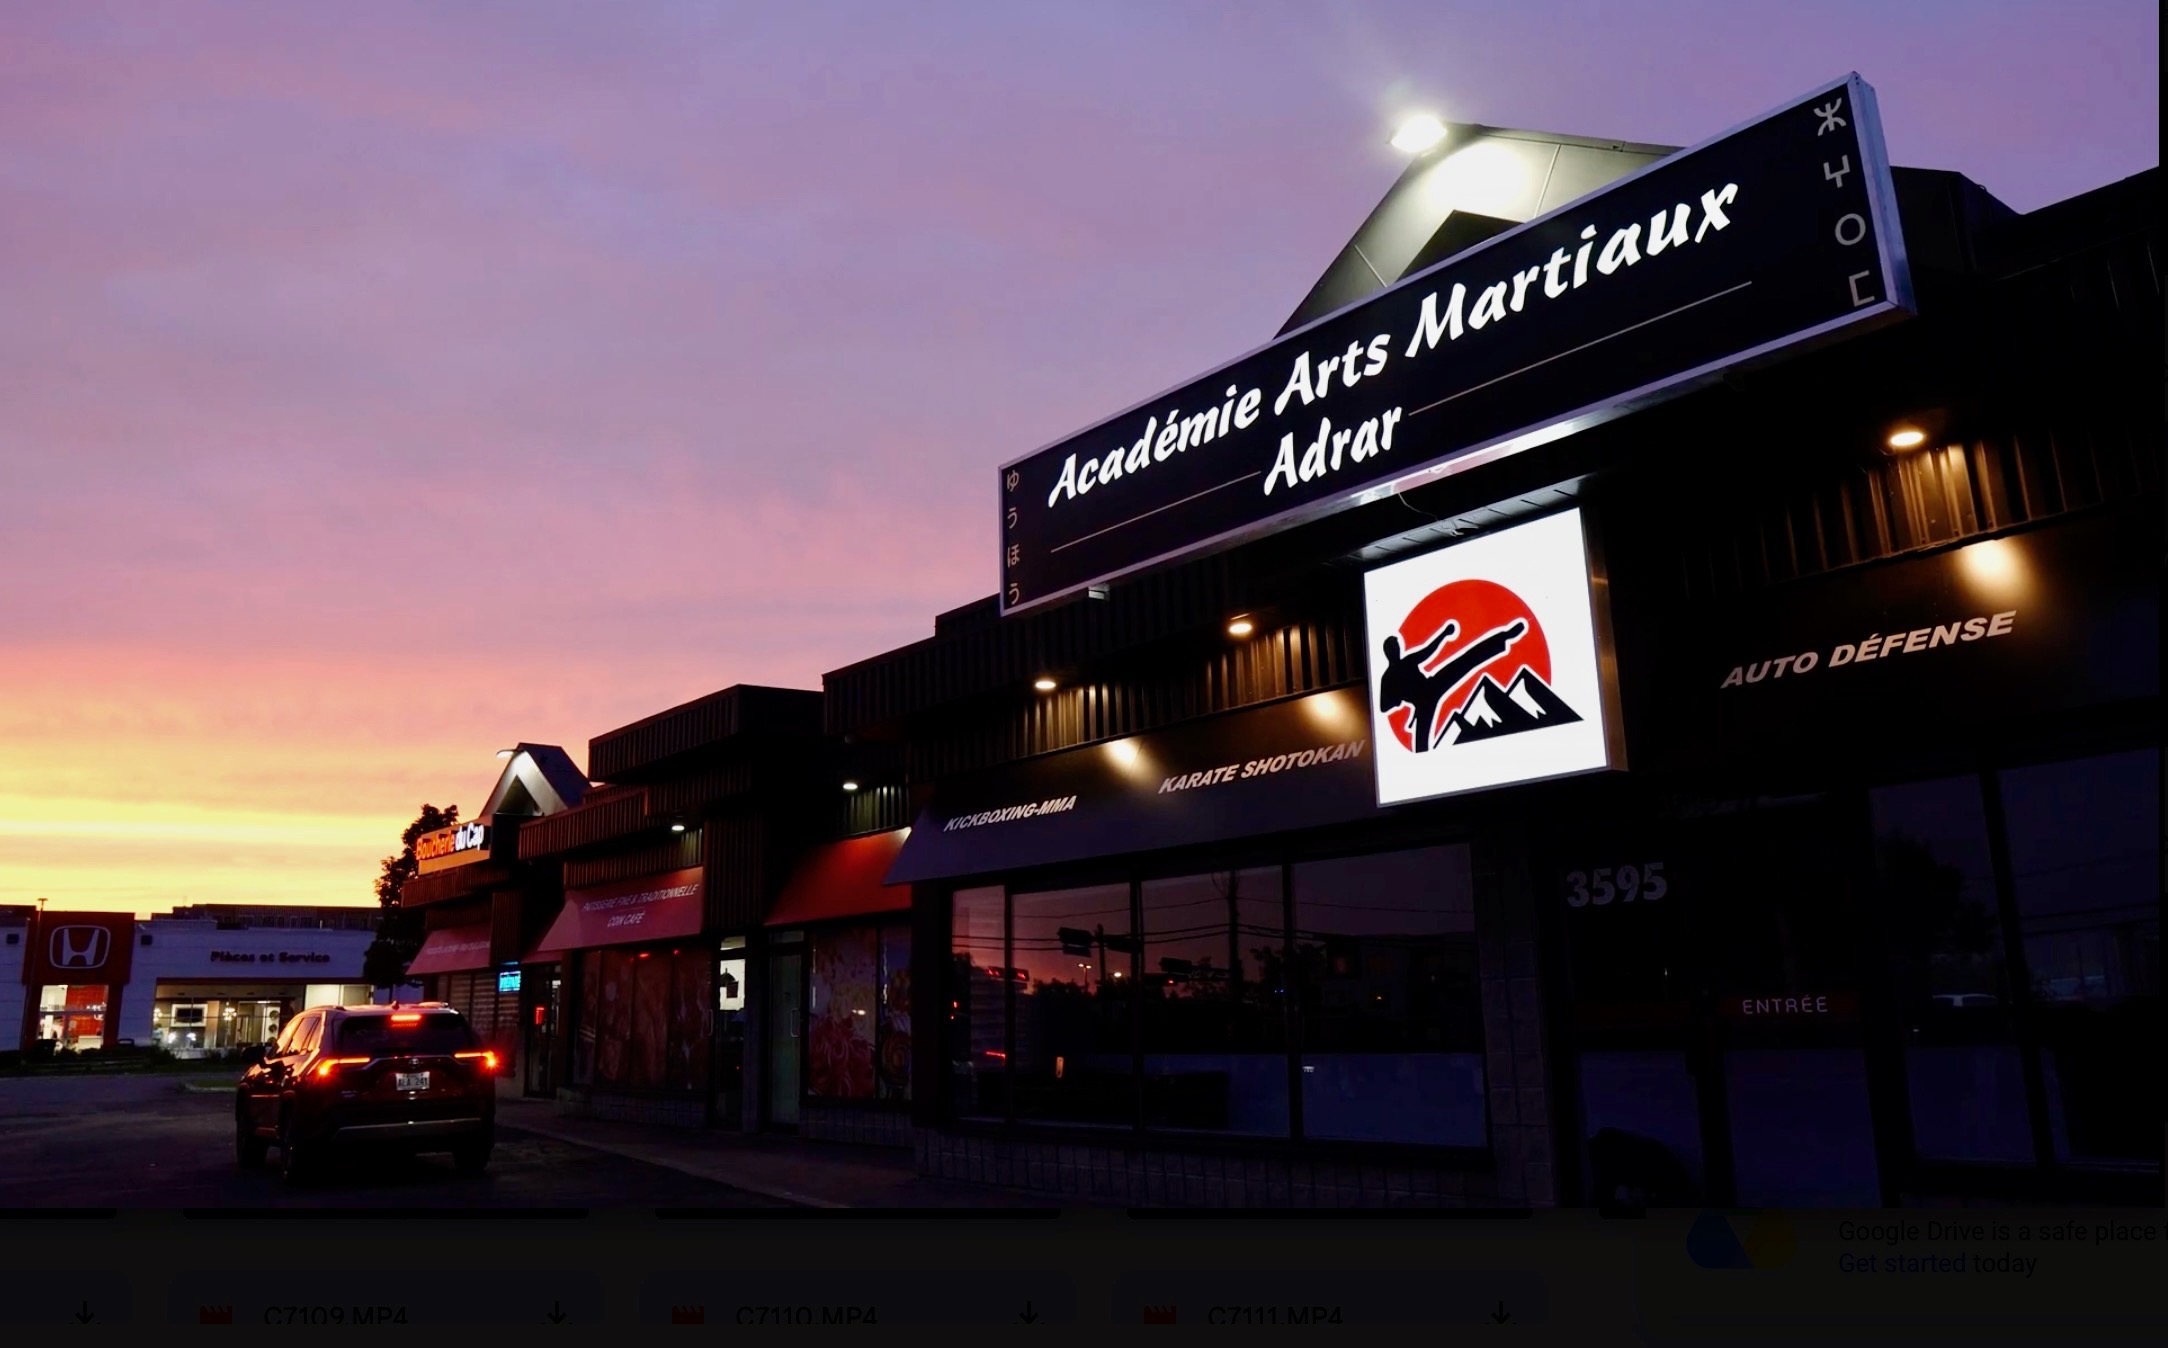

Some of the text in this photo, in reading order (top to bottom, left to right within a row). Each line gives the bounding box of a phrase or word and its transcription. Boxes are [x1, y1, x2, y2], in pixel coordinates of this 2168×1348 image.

[1048, 182, 1739, 508] Académie Arts Martiaux
[1263, 406, 1402, 496] Adrar
[1719, 609, 2018, 690] AUTO DÉFENSE
[1157, 739, 1366, 795] KARATE SHOTOKAN
[943, 795, 1078, 833] KICKBOXING-MMA
[455, 825, 467, 851] du
[466, 821, 485, 851] Cap
[1565, 860, 1669, 909] 3595
[210, 951, 330, 962] Pièces et Service
[1742, 994, 1828, 1016] ENTRÉE
[1839, 1220, 1920, 1246] Google
[1928, 1220, 1985, 1242] Drive
[1993, 1220, 2010, 1242] is
[2018, 1224, 2031, 1242] a
[2039, 1219, 2088, 1242] safe
[2096, 1220, 2157, 1246] place
[1839, 1252, 2038, 1279] Get started today
[264, 1305, 409, 1325] C7109MP4
[735, 1305, 878, 1325] C7110MP4
[1208, 1305, 1344, 1325] C7111MP4
